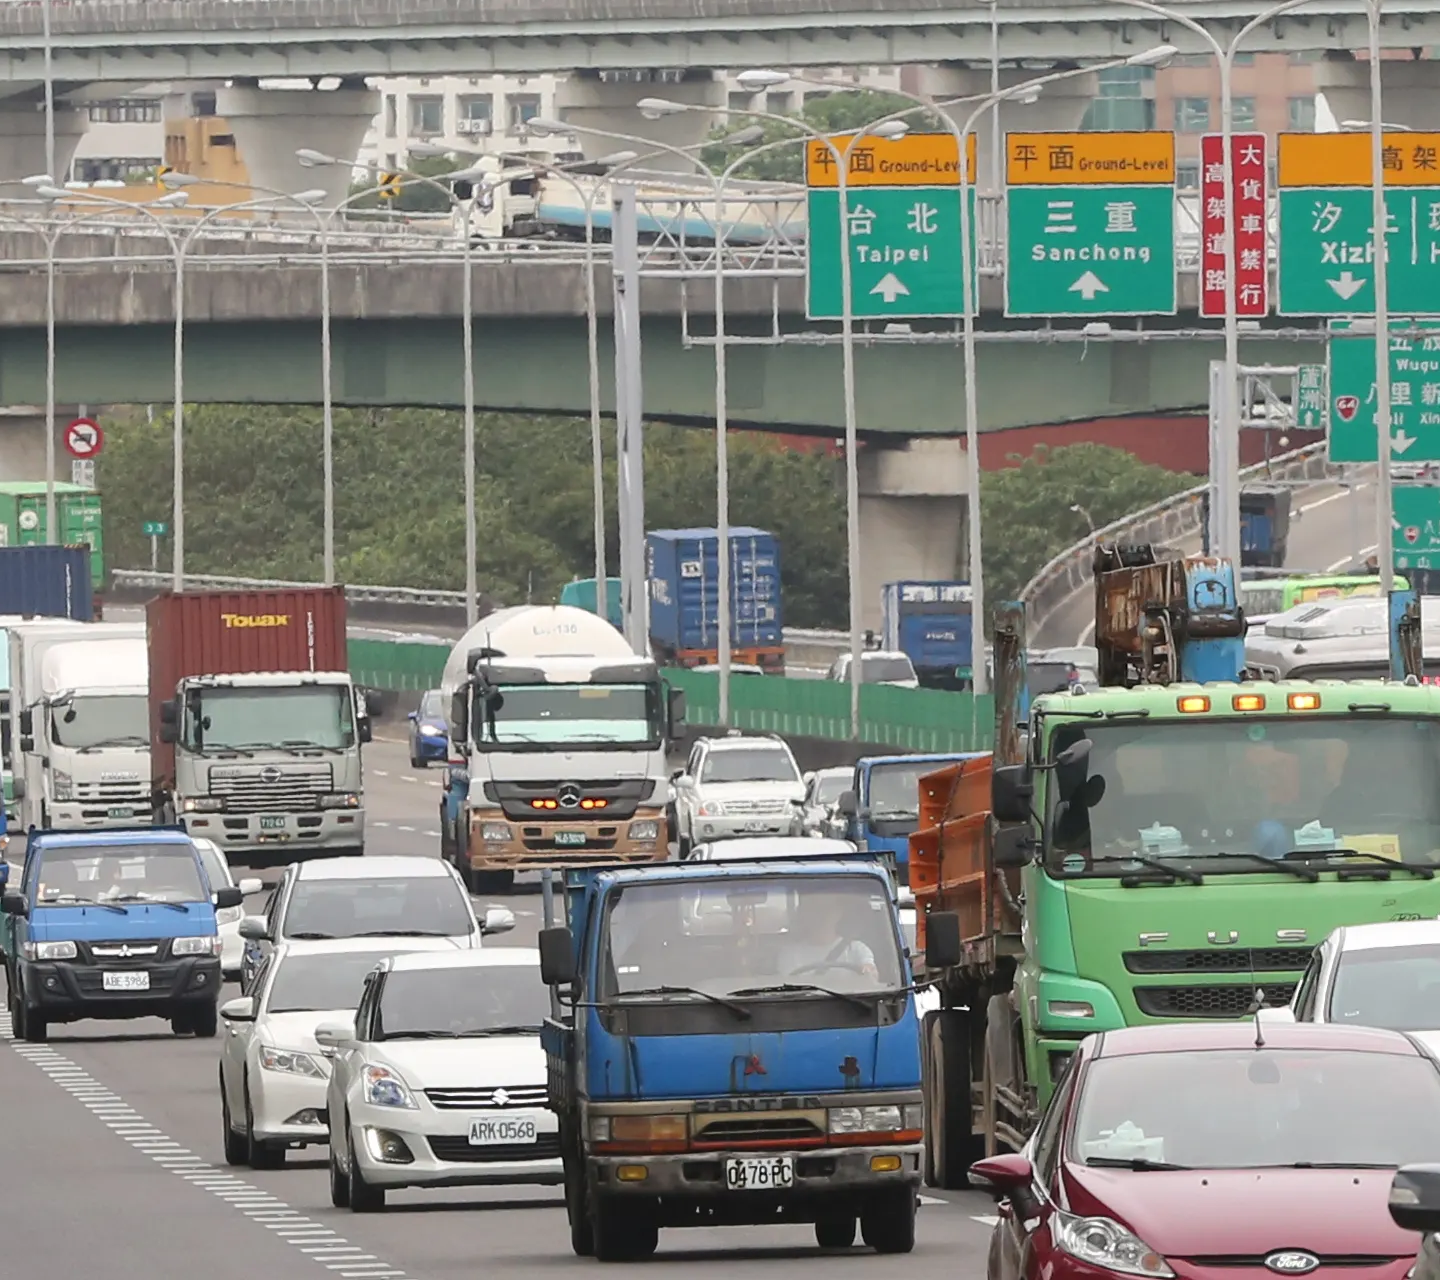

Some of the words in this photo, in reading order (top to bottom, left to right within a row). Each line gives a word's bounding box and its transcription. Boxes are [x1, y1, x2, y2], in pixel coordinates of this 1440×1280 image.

[814, 147, 875, 174] 平面
[1013, 145, 1074, 171] 平面
[1079, 150, 1168, 171] Ground-Level
[847, 203, 938, 236] 台北
[1044, 201, 1138, 233] 三重
[1205, 162, 1226, 291] 高架道路
[1240, 144, 1262, 307] 大貨車禁行
[857, 245, 929, 266] Taipei
[1032, 244, 1151, 264] Sanchong
[471, 1122, 535, 1140] ARK-0568
[728, 1165, 791, 1187] 0478-PC
[1277, 1255, 1307, 1268] Ford
